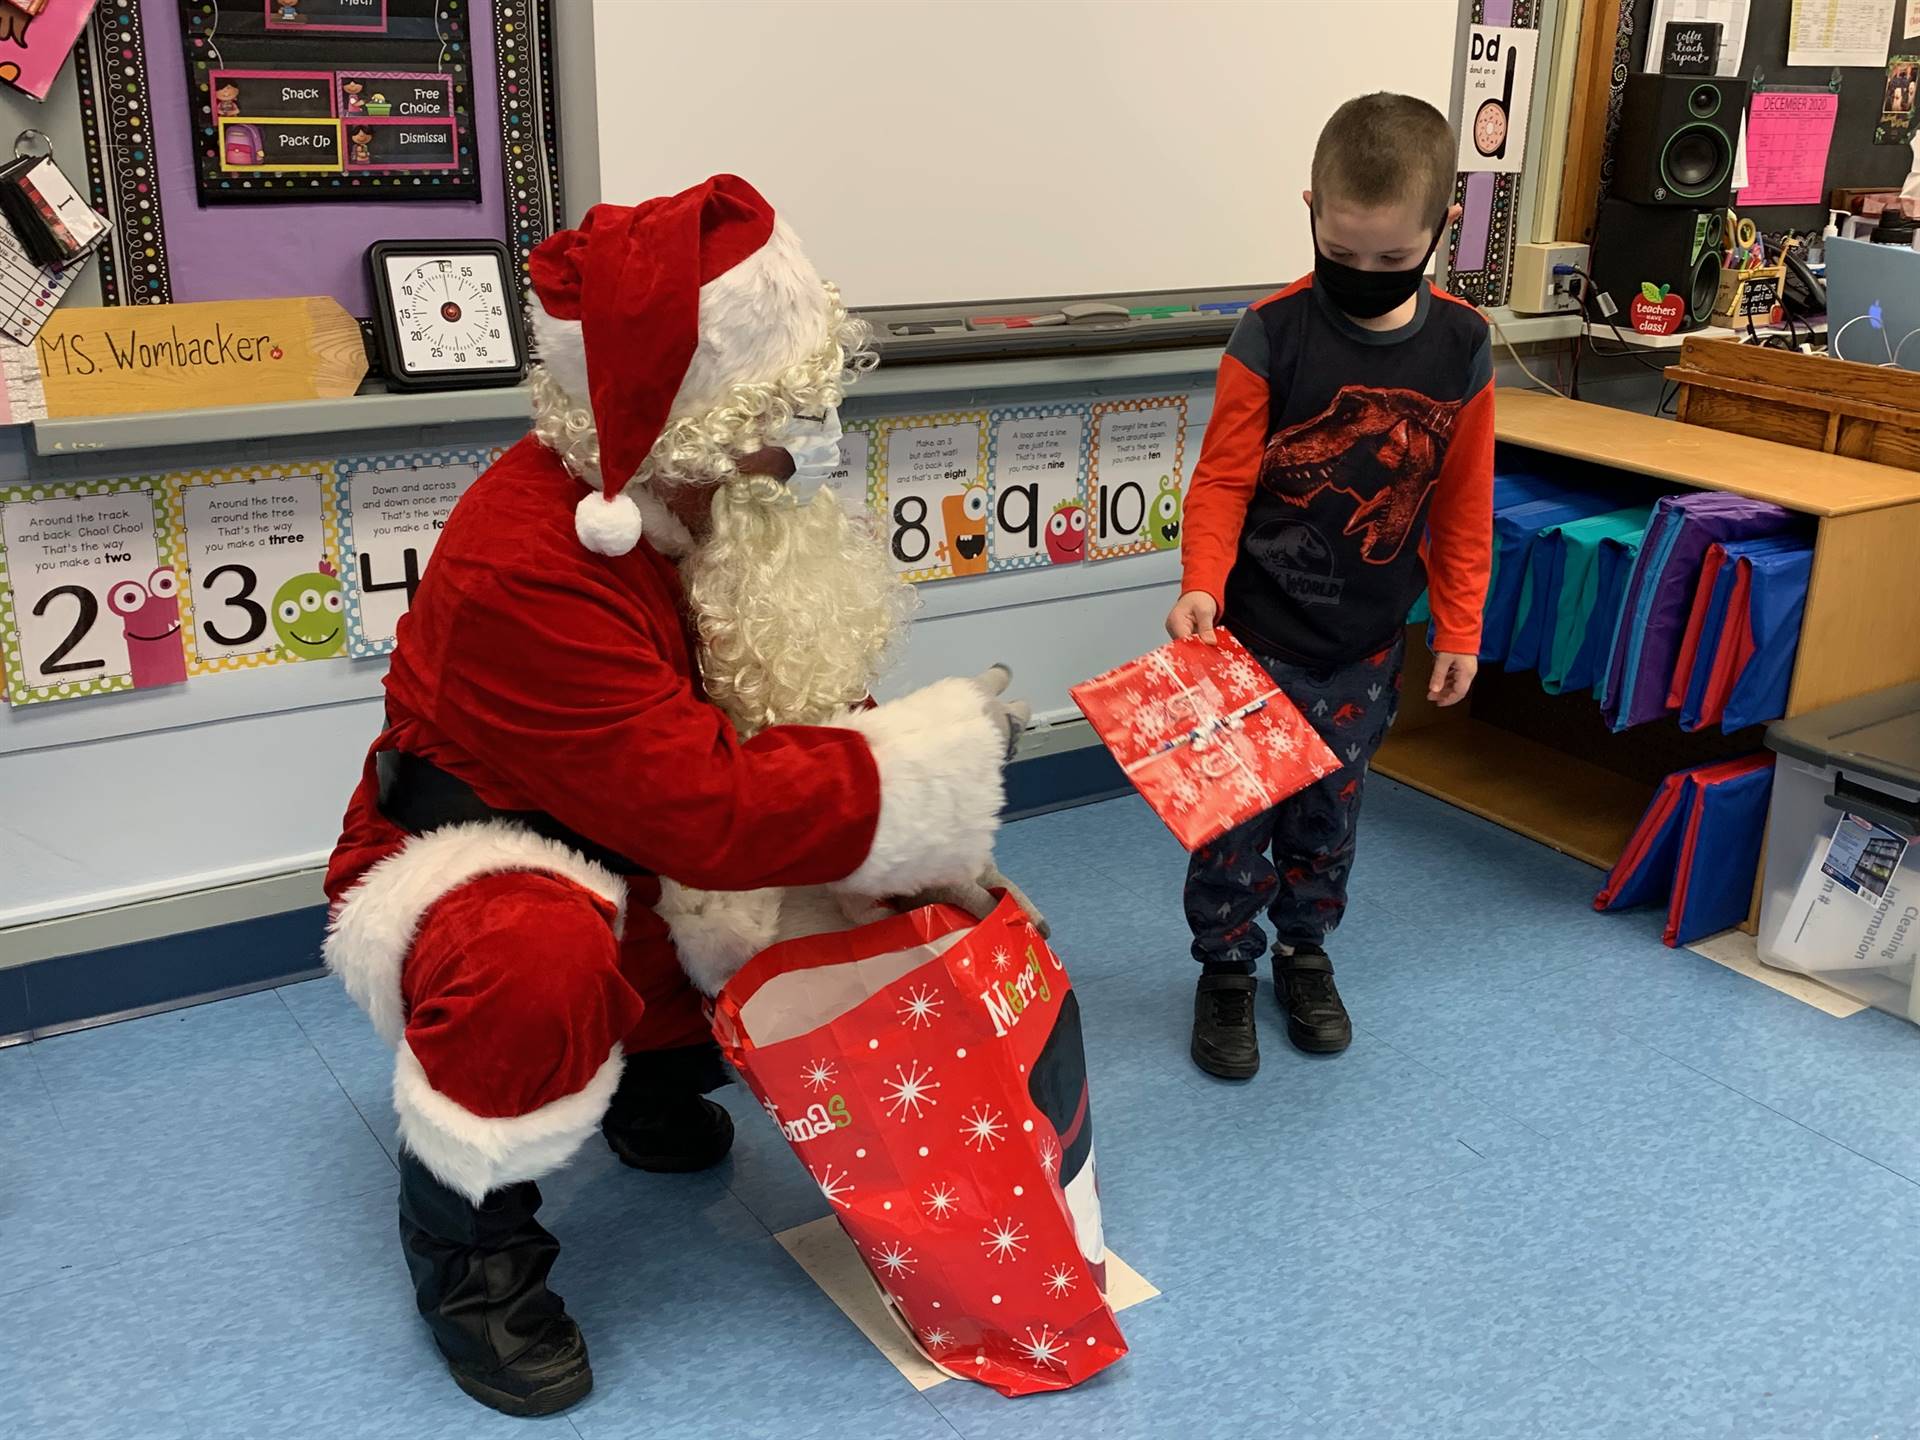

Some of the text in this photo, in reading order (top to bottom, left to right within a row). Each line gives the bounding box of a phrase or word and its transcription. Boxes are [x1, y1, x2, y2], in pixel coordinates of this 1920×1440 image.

[1471, 33, 1501, 62] Dd
[1676, 41, 1704, 53] teach
[1667, 52, 1705, 66] repeat
[282, 87, 319, 101] Snack
[414, 88, 440, 100] Free
[400, 102, 441, 115] Choice
[1763, 97, 1828, 111] DECEMBER 2020
[279, 134, 331, 149] Pack Up
[400, 132, 447, 145] Dismissal
[417, 268, 424, 279] 5
[461, 267, 473, 277] 55
[401, 285, 413, 296] 10
[481, 282, 492, 293] 50
[400, 308, 411, 319] 15
[491, 306, 502, 316] 45
[1637, 303, 1678, 316] teachers
[489, 329, 500, 339] 40
[1639, 321, 1667, 334] class!
[411, 330, 422, 341] 20
[40, 332, 103, 377] MS.
[431, 347, 443, 358] 25
[454, 352, 466, 363] 30
[476, 346, 488, 357] 35
[1012, 431, 1018, 439] A
[1020, 430, 1034, 440] loop
[1036, 429, 1049, 438] and
[1056, 428, 1067, 436] line
[1126, 432, 1147, 441] around
[916, 438, 935, 448] Make
[1017, 442, 1030, 450] are
[1031, 440, 1044, 451] just
[909, 451, 921, 460] but
[1049, 450, 1062, 460] way
[1124, 454, 1141, 463] make
[1148, 451, 1161, 460] ten
[913, 461, 953, 471] Go back up
[1021, 462, 1040, 472] make
[1047, 459, 1065, 470] nine
[828, 470, 849, 479] ven
[897, 469, 967, 484] and that's an eight
[372, 481, 456, 495] Down and across
[208, 497, 249, 510] Around
[251, 495, 268, 506] the
[362, 499, 381, 510] and
[384, 497, 410, 508] down
[412, 496, 436, 506] once
[210, 507, 295, 524] around the tree
[381, 510, 411, 521] That's
[414, 508, 430, 518] the
[1099, 481, 1146, 539] 10
[29, 508, 130, 527] Around the track
[18, 532, 40, 543] and
[78, 525, 110, 538] Choo!
[113, 522, 144, 535] Choo!
[218, 522, 293, 537] That's the way
[373, 519, 448, 538] you make a fo
[892, 496, 930, 563] 8
[42, 539, 124, 555] That's the way
[205, 533, 305, 554] you make a three
[35, 552, 132, 574] you make a two
[359, 547, 425, 613] 4
[1286, 573, 1341, 597] WORLD
[202, 564, 267, 646] 3
[32, 584, 106, 675] 2
[1854, 886, 1900, 960] Information
[1881, 905, 1919, 960] Cleaning
[979, 944, 1051, 1037] Merry
